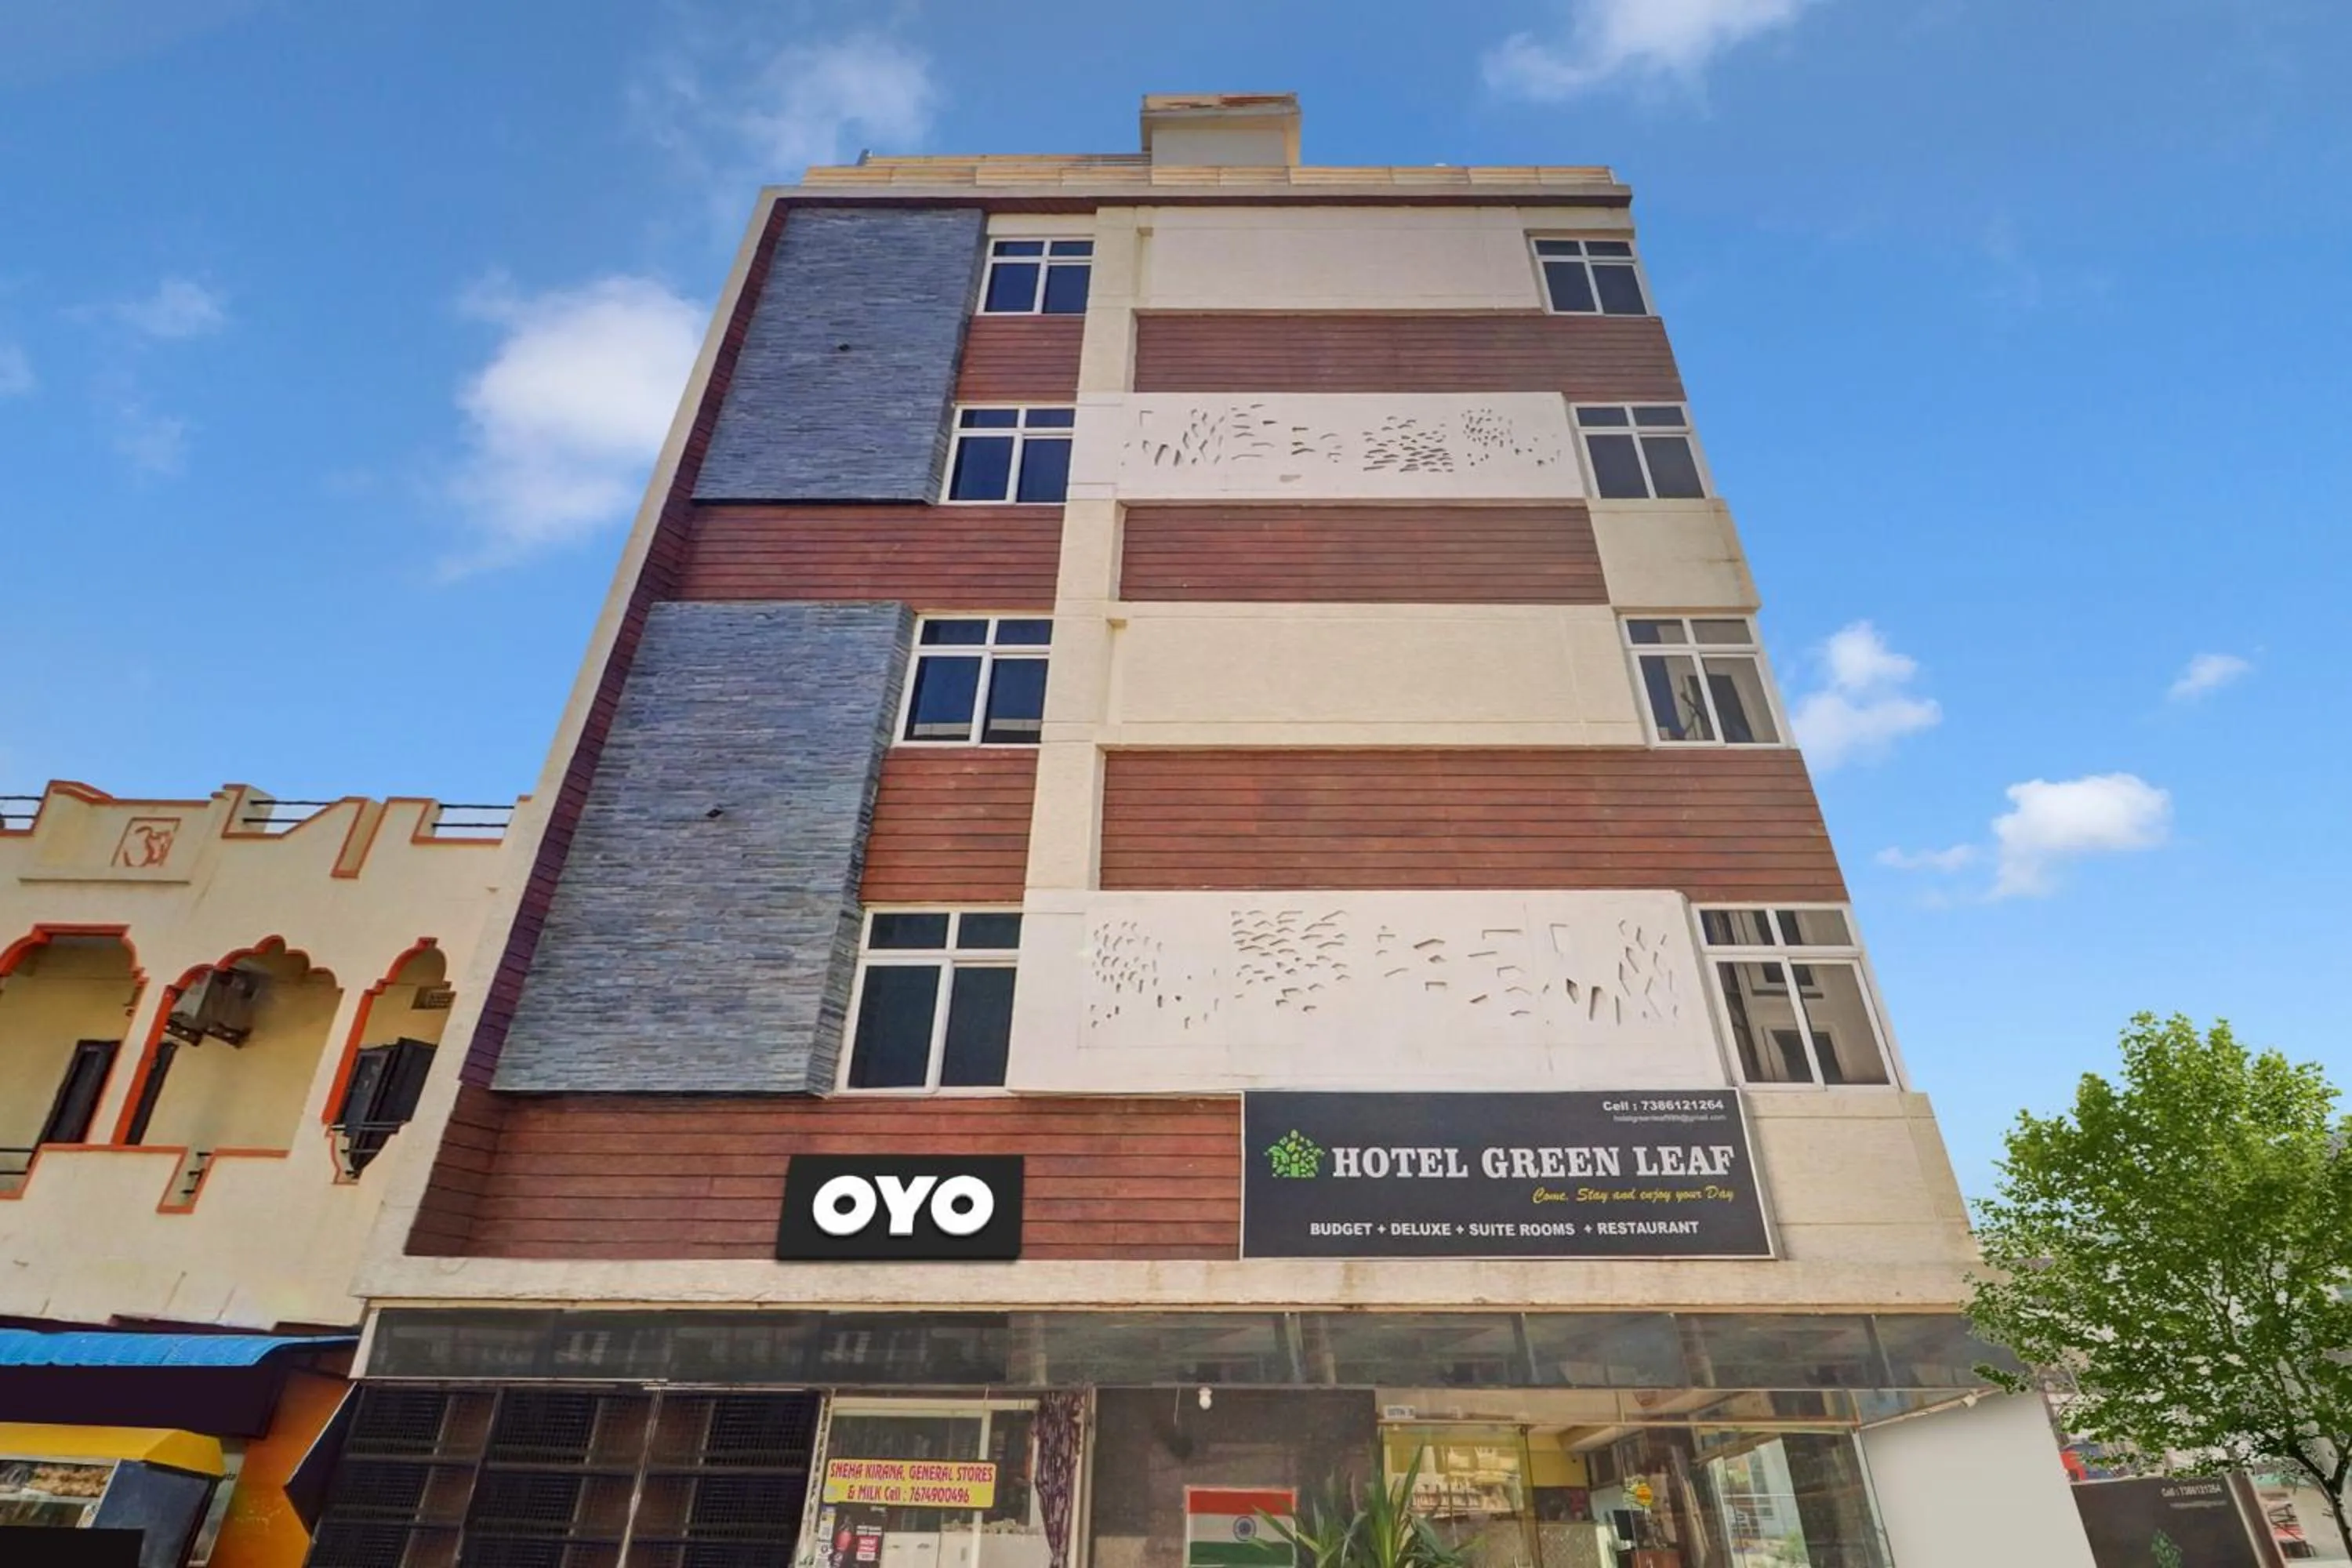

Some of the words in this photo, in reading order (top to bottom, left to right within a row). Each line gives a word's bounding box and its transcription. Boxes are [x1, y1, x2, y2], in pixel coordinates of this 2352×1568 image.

[1602, 1100, 1629, 1111] Cell
[1640, 1099, 1724, 1111] 7386121264
[1332, 1147, 1468, 1178] HOTEL
[1481, 1146, 1621, 1178] GREEN
[1632, 1145, 1735, 1176] LEAF
[1576, 1187, 1608, 1203] Stay
[1613, 1187, 1635, 1201] and
[1639, 1188, 1671, 1203] enjoy
[1675, 1189, 1702, 1204] your
[1704, 1185, 1734, 1203] Day
[812, 1174, 995, 1236] OYO
[1309, 1222, 1373, 1236] BUDGET
[1390, 1222, 1451, 1236] DELUXE
[1468, 1222, 1515, 1236] SUITE
[1519, 1222, 1576, 1236] ROOMS
[1596, 1221, 1700, 1236] RESTAURANT
[909, 1465, 953, 1482] GENERAL
[956, 1466, 993, 1483] STORES
[858, 1485, 882, 1501] MILK
